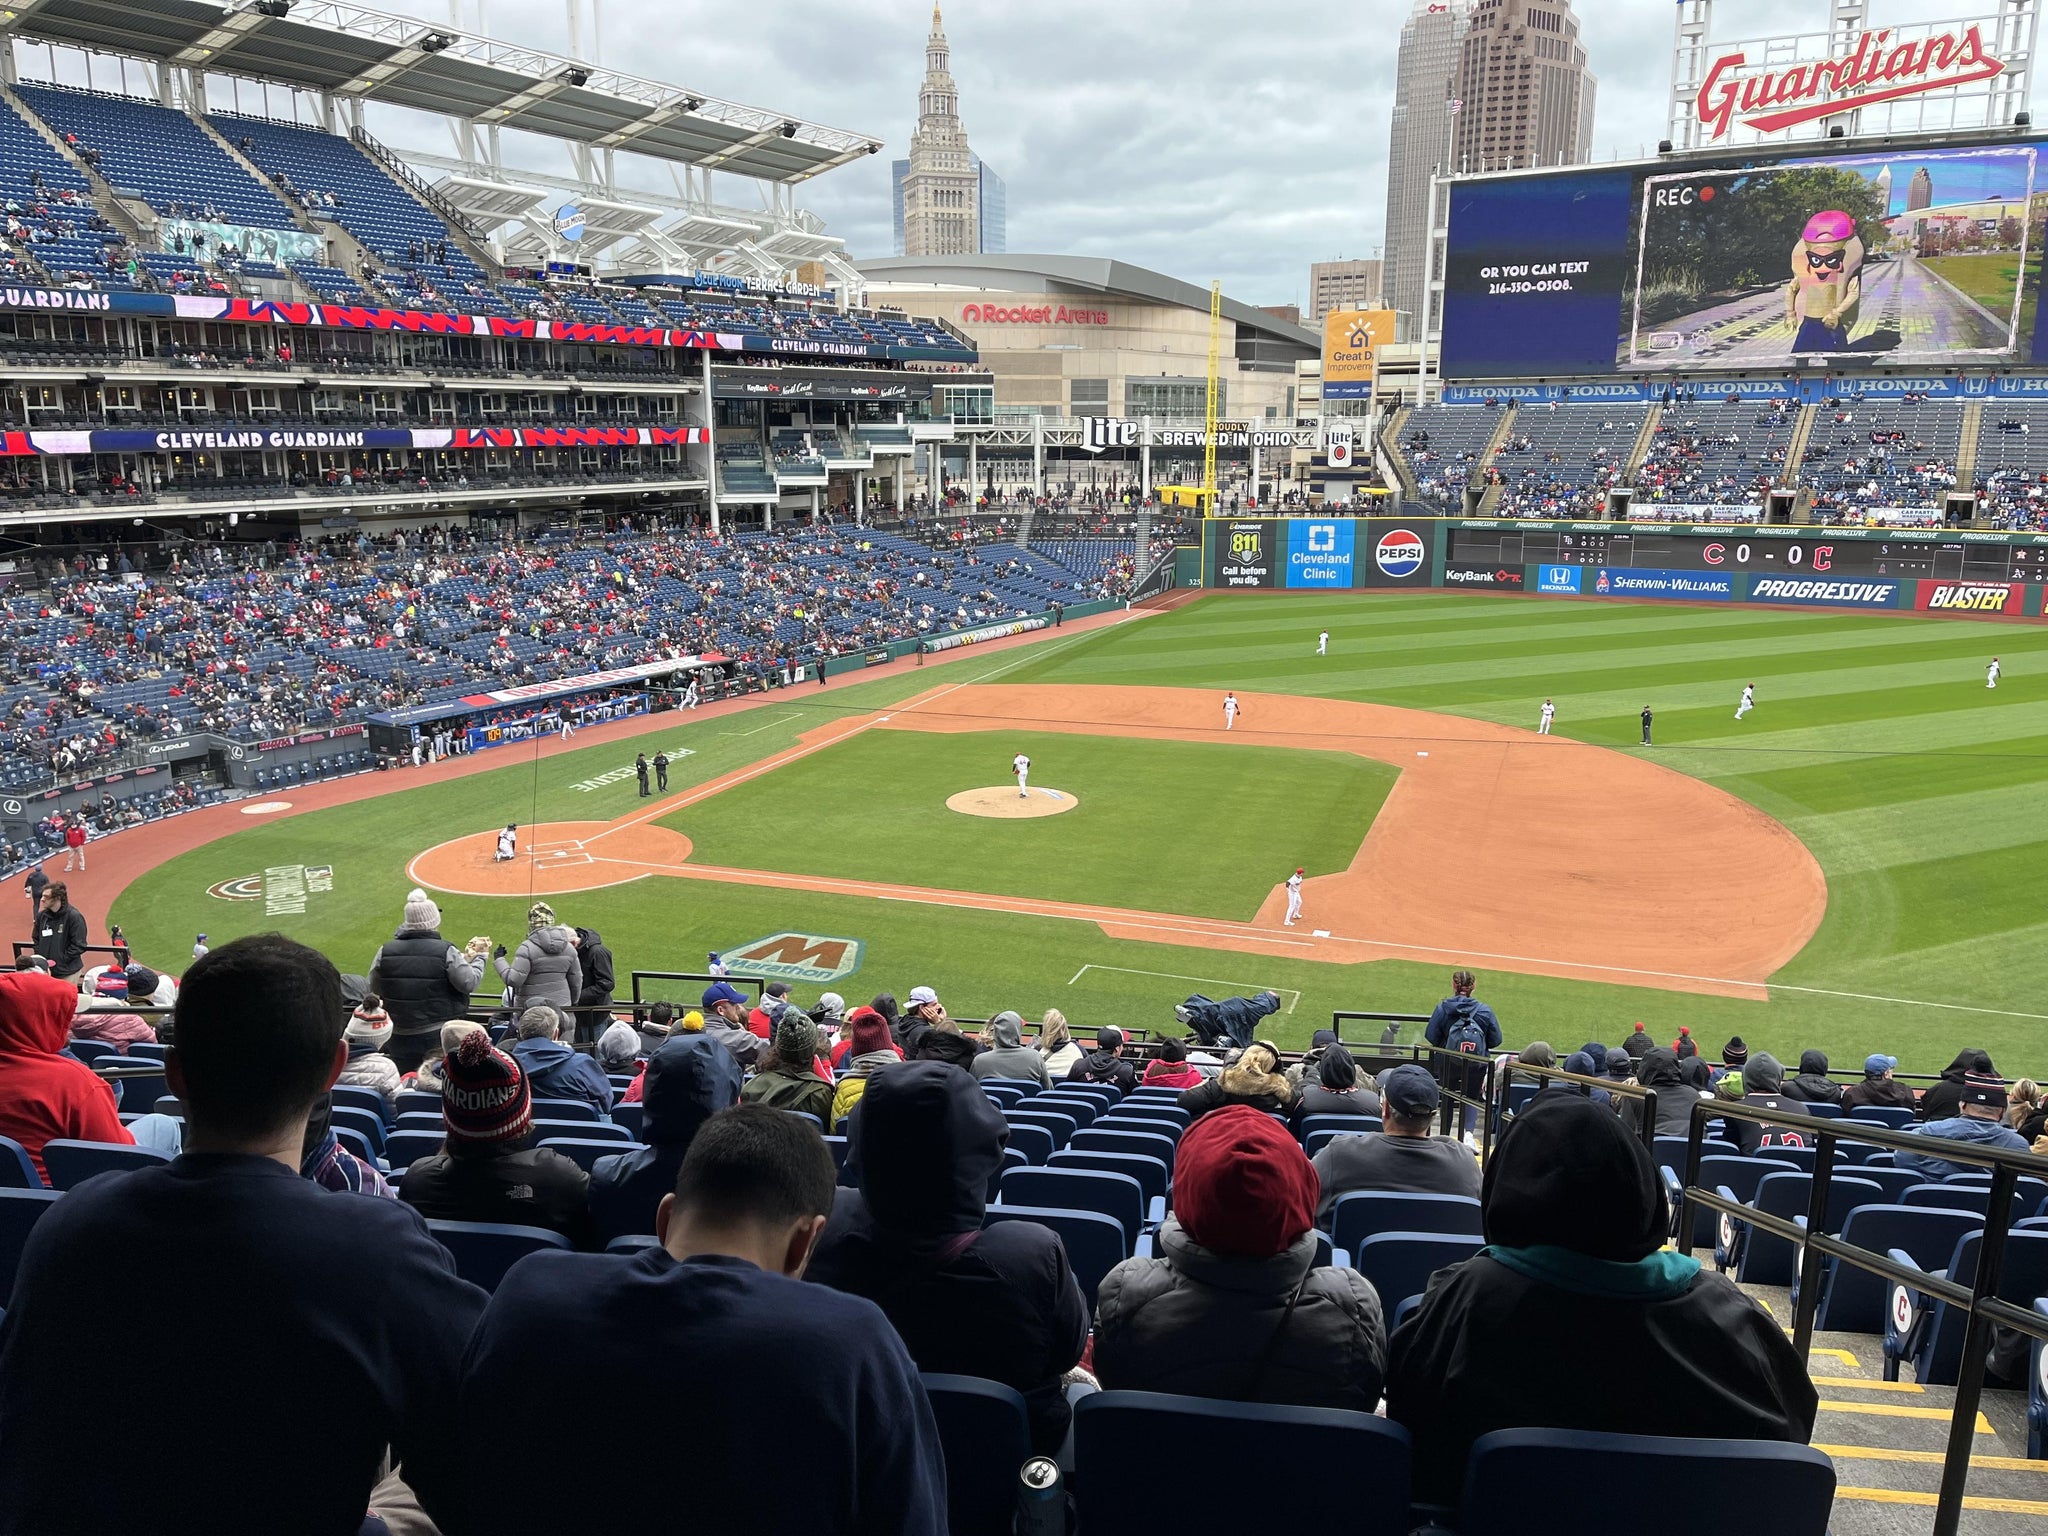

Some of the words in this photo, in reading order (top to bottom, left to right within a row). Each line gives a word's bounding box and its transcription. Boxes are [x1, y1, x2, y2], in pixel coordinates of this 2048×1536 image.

[1697, 22, 2006, 142] Guardians
[1654, 186, 1693, 207] REC
[1480, 267, 1499, 279] OR
[1501, 265, 1528, 277] YOU
[1531, 263, 1557, 275] CAN
[1559, 261, 1590, 274] TEXT
[694, 269, 714, 287] BLUE
[719, 273, 743, 289] MOON
[746, 276, 784, 291] TERRACE
[785, 281, 820, 297] GARDEN
[982, 303, 1052, 324] Rocket
[1054, 304, 1109, 325] Arena
[771, 339, 820, 353] CLEVELAND
[822, 342, 867, 356] GUARDIANS
[1333, 350, 1362, 361] Great
[1364, 350, 1374, 361] D
[747, 384, 769, 393] KeyBank
[1566, 384, 1641, 397] HONDA
[1702, 382, 1787, 395] HONDA
[1858, 379, 1949, 391] HONDA
[1467, 386, 1540, 398] HONDA
[156, 432, 264, 449] CLEVELAND
[269, 430, 364, 448] GUARDIANS
[1079, 416, 1139, 453] Lite
[1232, 431, 1250, 447] IN
[1253, 431, 1291, 447] OHIO
[1331, 431, 1351, 444] Lite
[1515, 521, 1555, 529] PROGRESSIVE
[1571, 522, 1613, 530] PROGRESSIVE
[1630, 524, 1672, 532] PROGRESSIVE
[1755, 527, 1801, 535] PROGRESSIVE
[1821, 529, 1869, 537] PROGRESSIVE
[1890, 530, 1939, 539] PROGRESSIVE
[1960, 532, 2011, 541] PROGRESSIVE
[1232, 532, 1259, 552] 811
[1292, 552, 1350, 564] Cleveland
[1379, 548, 1421, 559] PEPSI
[1703, 543, 1726, 565] C
[1736, 544, 1750, 563] 0
[1787, 545, 1802, 564] 0
[1813, 546, 1834, 571] C
[1222, 566, 1238, 575] Call
[1240, 566, 1267, 575] before
[1303, 568, 1337, 579] Clinic
[1446, 569, 1494, 583] KeyBank
[1229, 577, 1244, 586] you
[1244, 576, 1260, 585] dig.
[1541, 584, 1576, 592] HONDA
[1752, 579, 1895, 603] PROGRESSIVE
[1929, 586, 2009, 610] BLASTER
[160, 741, 190, 751] LEXUS
[726, 958, 835, 979] Marathon
[1897, 1295, 1908, 1322] C
